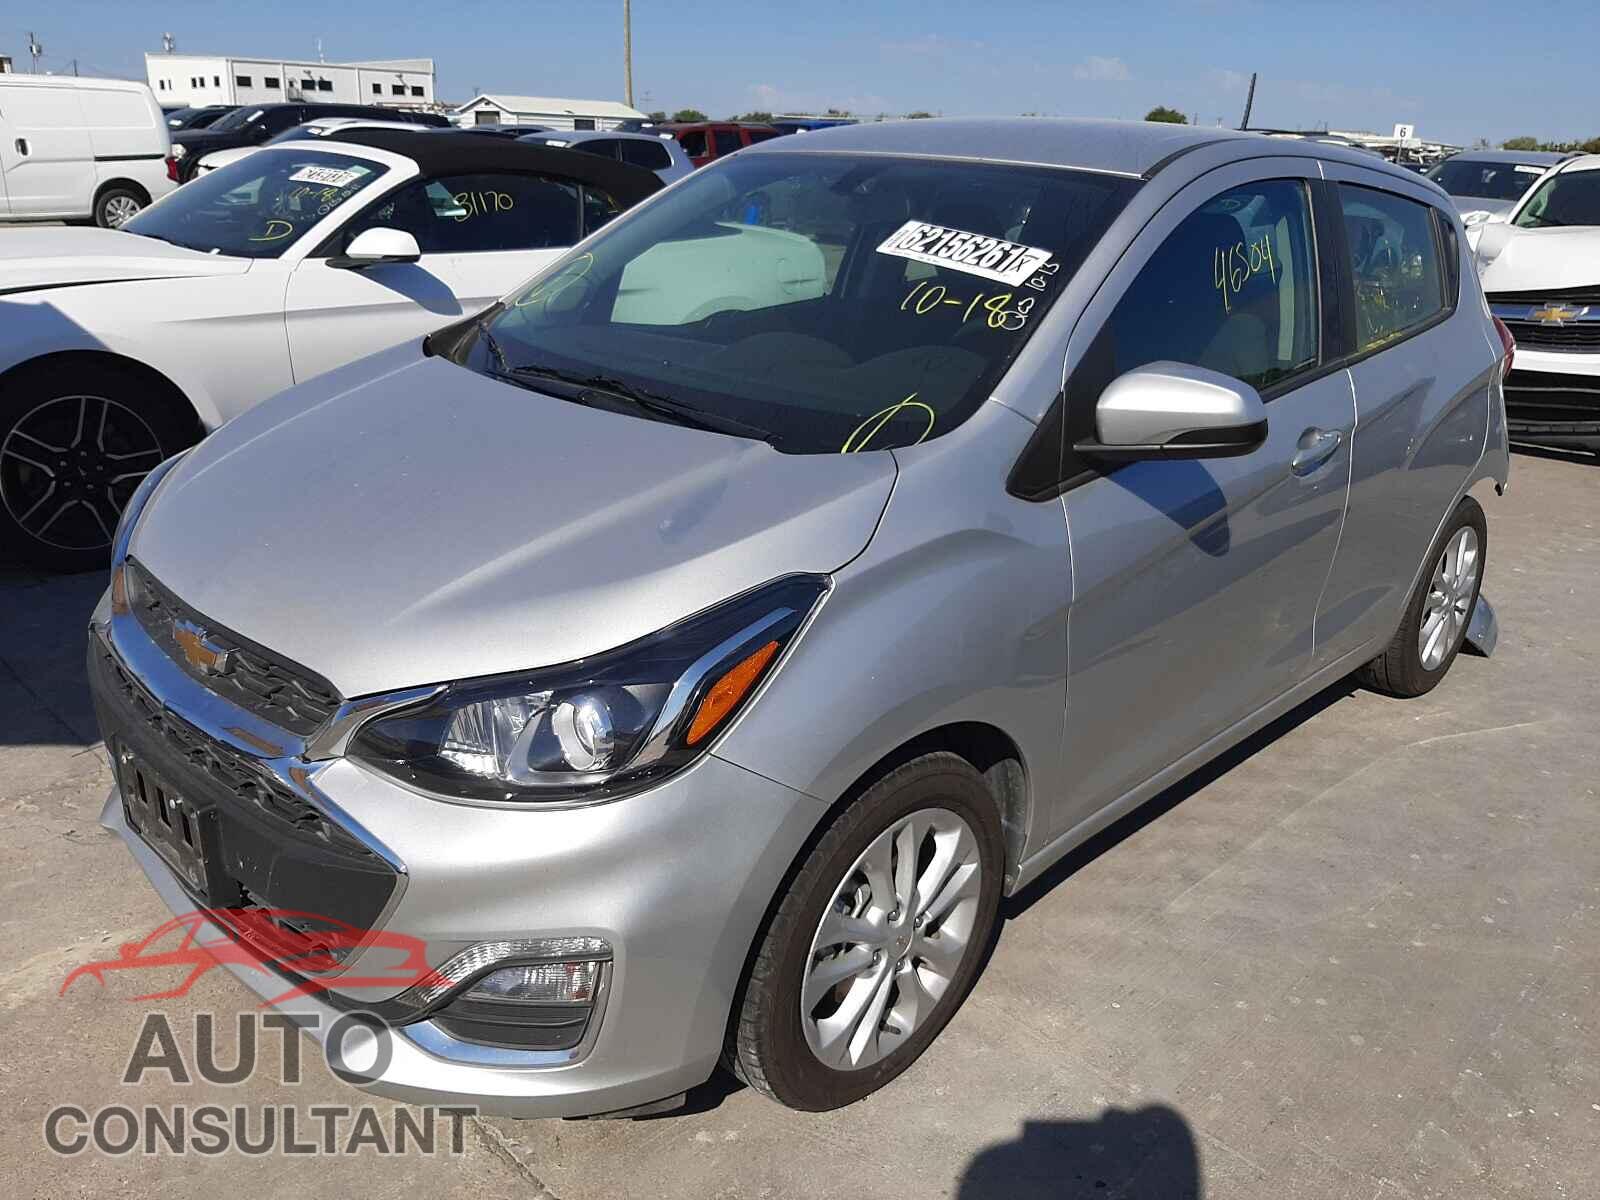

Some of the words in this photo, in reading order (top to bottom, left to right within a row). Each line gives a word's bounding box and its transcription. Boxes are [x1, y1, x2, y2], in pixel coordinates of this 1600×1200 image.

[1399, 127, 1407, 138] 6
[453, 191, 514, 222] 31170
[899, 225, 1025, 272] 62156261
[1214, 234, 1277, 314] 46504
[900, 281, 1013, 328] 10-18
